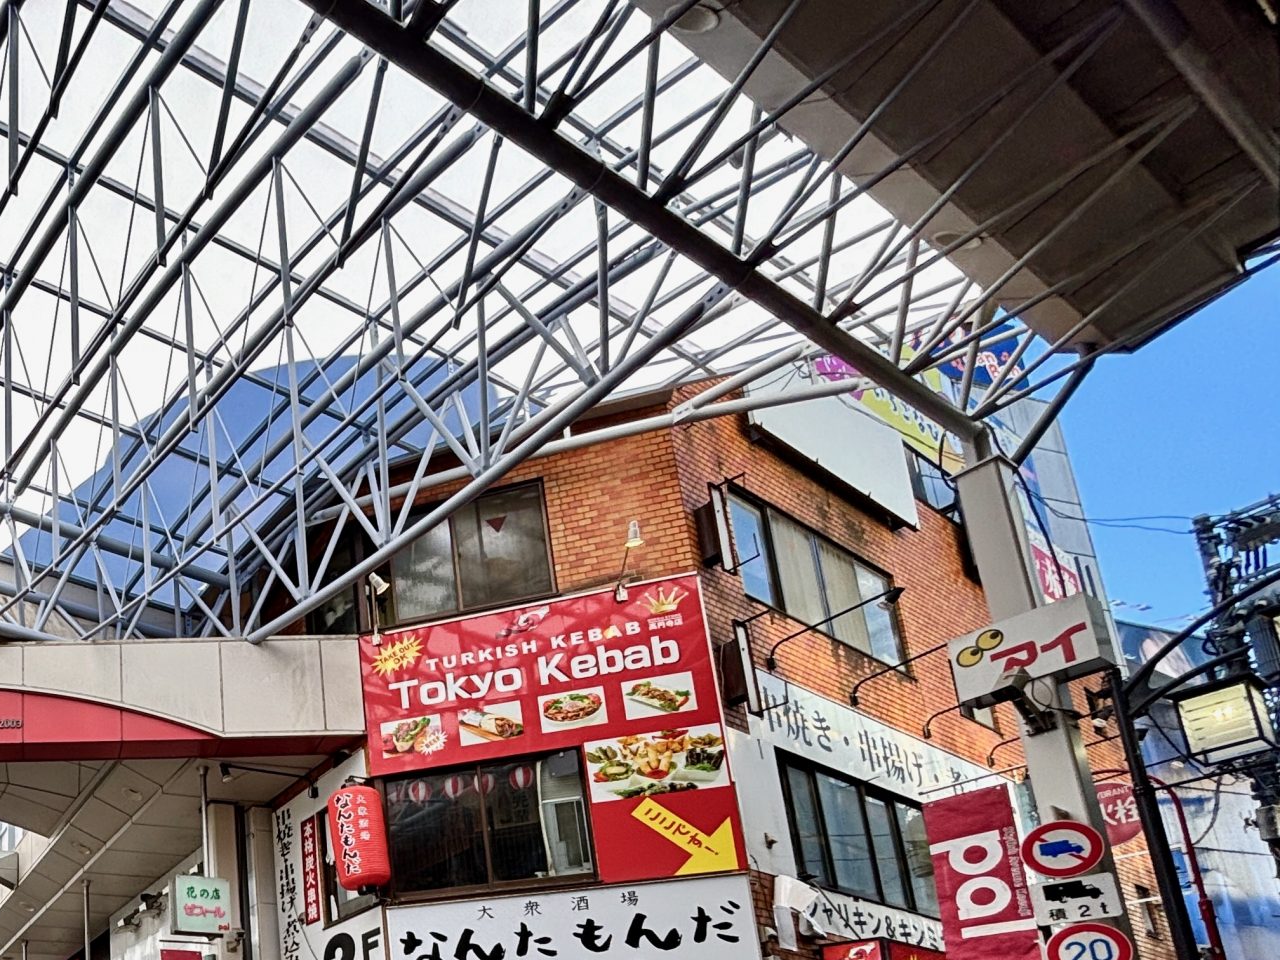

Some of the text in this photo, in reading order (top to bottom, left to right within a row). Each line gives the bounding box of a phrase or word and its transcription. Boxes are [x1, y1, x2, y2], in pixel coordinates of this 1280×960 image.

[379, 642, 416, 665] TAKE OUT
[393, 654, 408, 665] OK
[426, 621, 641, 672] TURKISH KEBAB
[388, 636, 681, 710] Tokyo Kebab
[334, 793, 362, 876] なんたもんだ
[186, 886, 221, 900] 花の店
[303, 822, 318, 920] 本格炭火串焼
[929, 829, 1038, 939] pal
[477, 891, 640, 920] 大衆酒場
